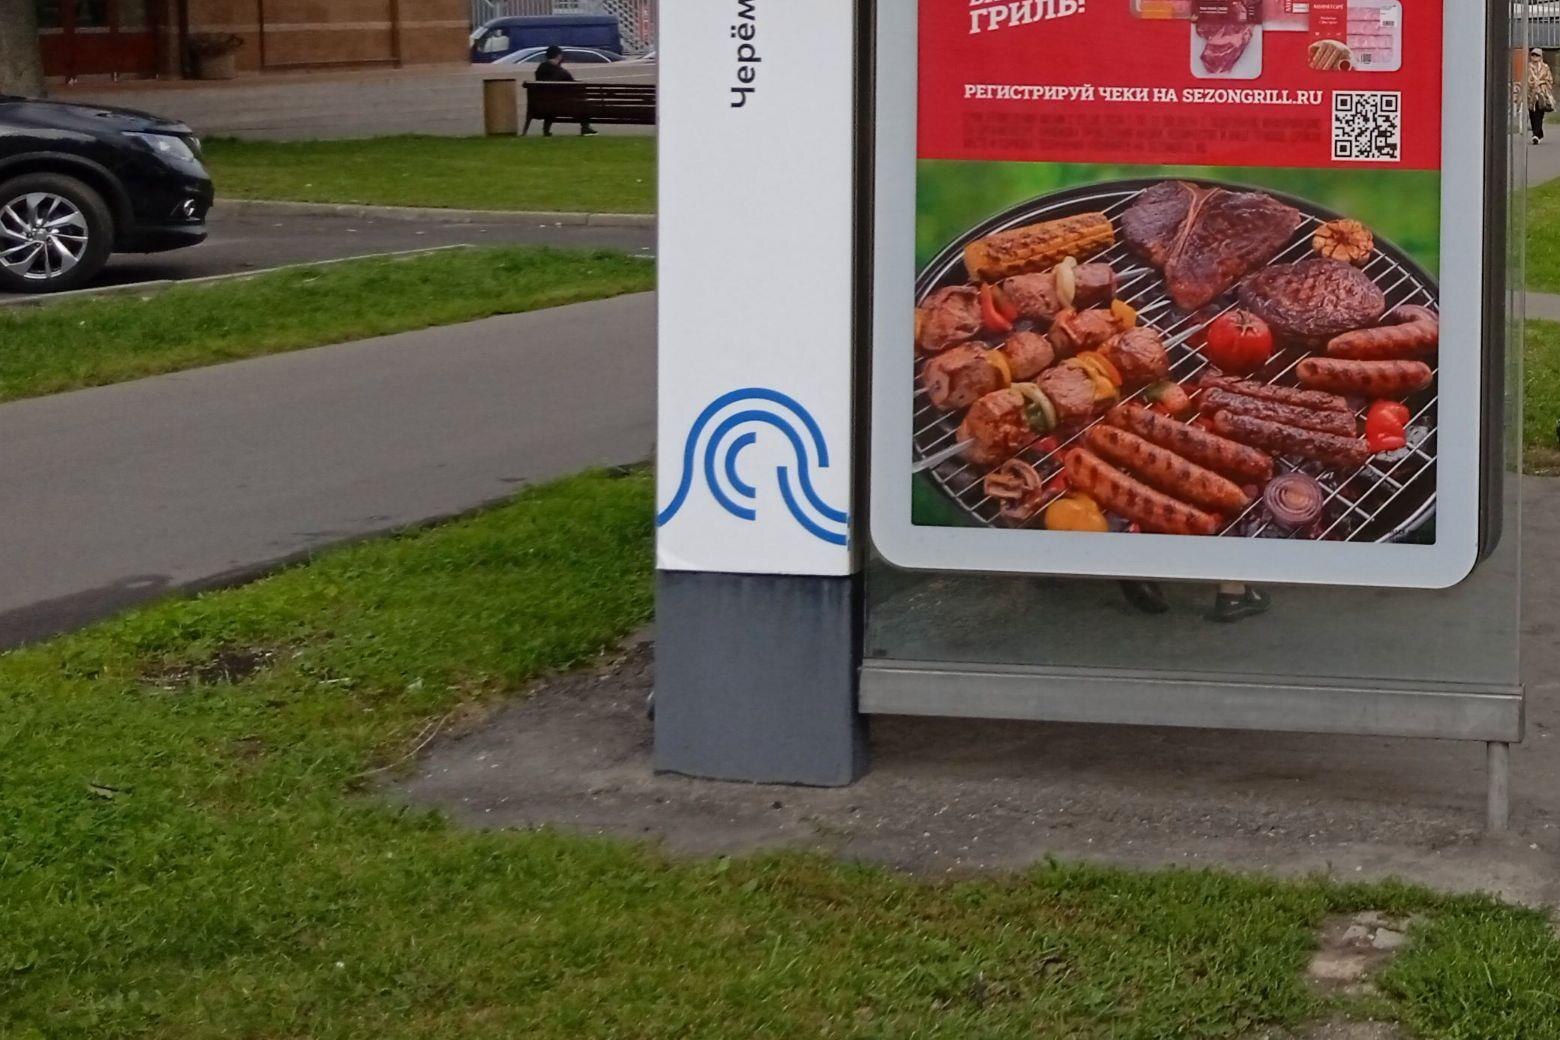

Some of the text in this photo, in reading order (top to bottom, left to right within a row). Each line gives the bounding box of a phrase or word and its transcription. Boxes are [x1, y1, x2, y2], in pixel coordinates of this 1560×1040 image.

[964, 84, 1323, 105] РЕГИСТРИРУЙ ЧЕКИ НА SEZONGRILL.RU
